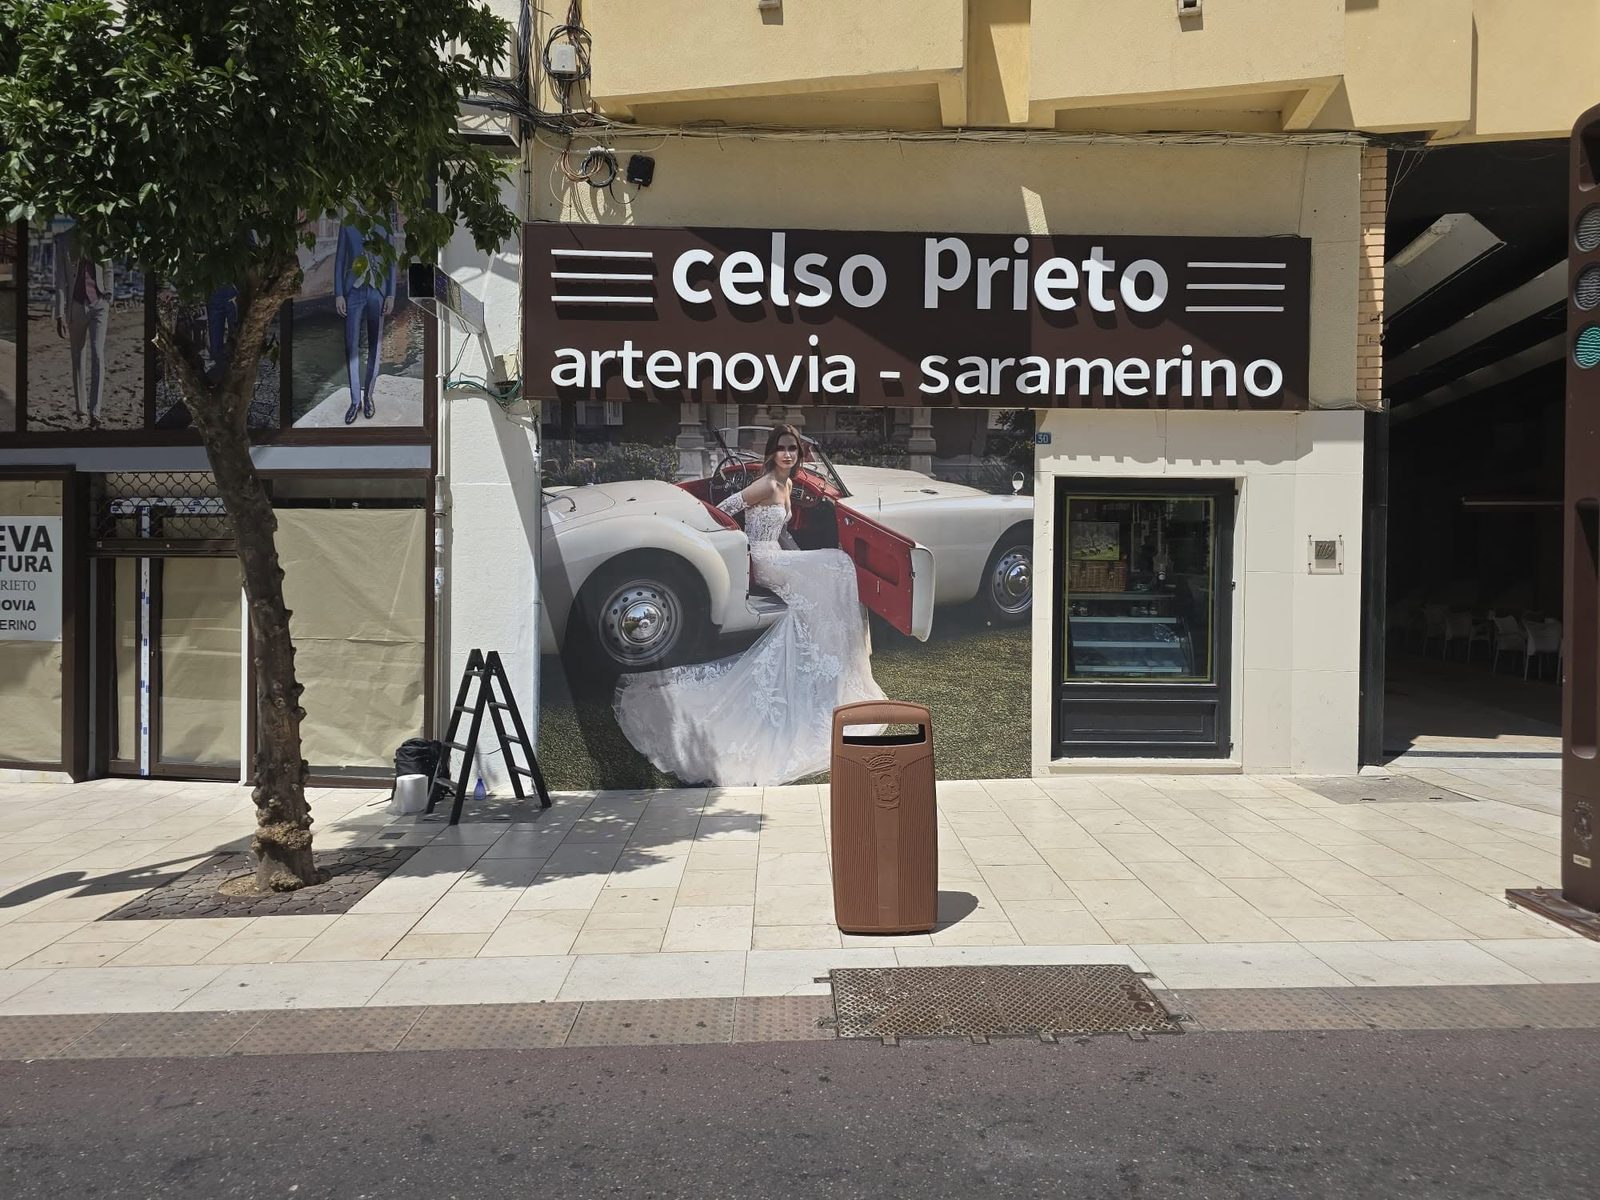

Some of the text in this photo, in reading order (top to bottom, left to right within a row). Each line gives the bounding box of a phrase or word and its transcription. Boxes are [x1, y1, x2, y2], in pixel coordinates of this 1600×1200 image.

[672, 231, 887, 309] celso
[550, 334, 856, 394] artenovia
[918, 344, 1284, 398] saramerino
[0, 580, 37, 592] RIETO
[0, 620, 37, 631] ERINO
